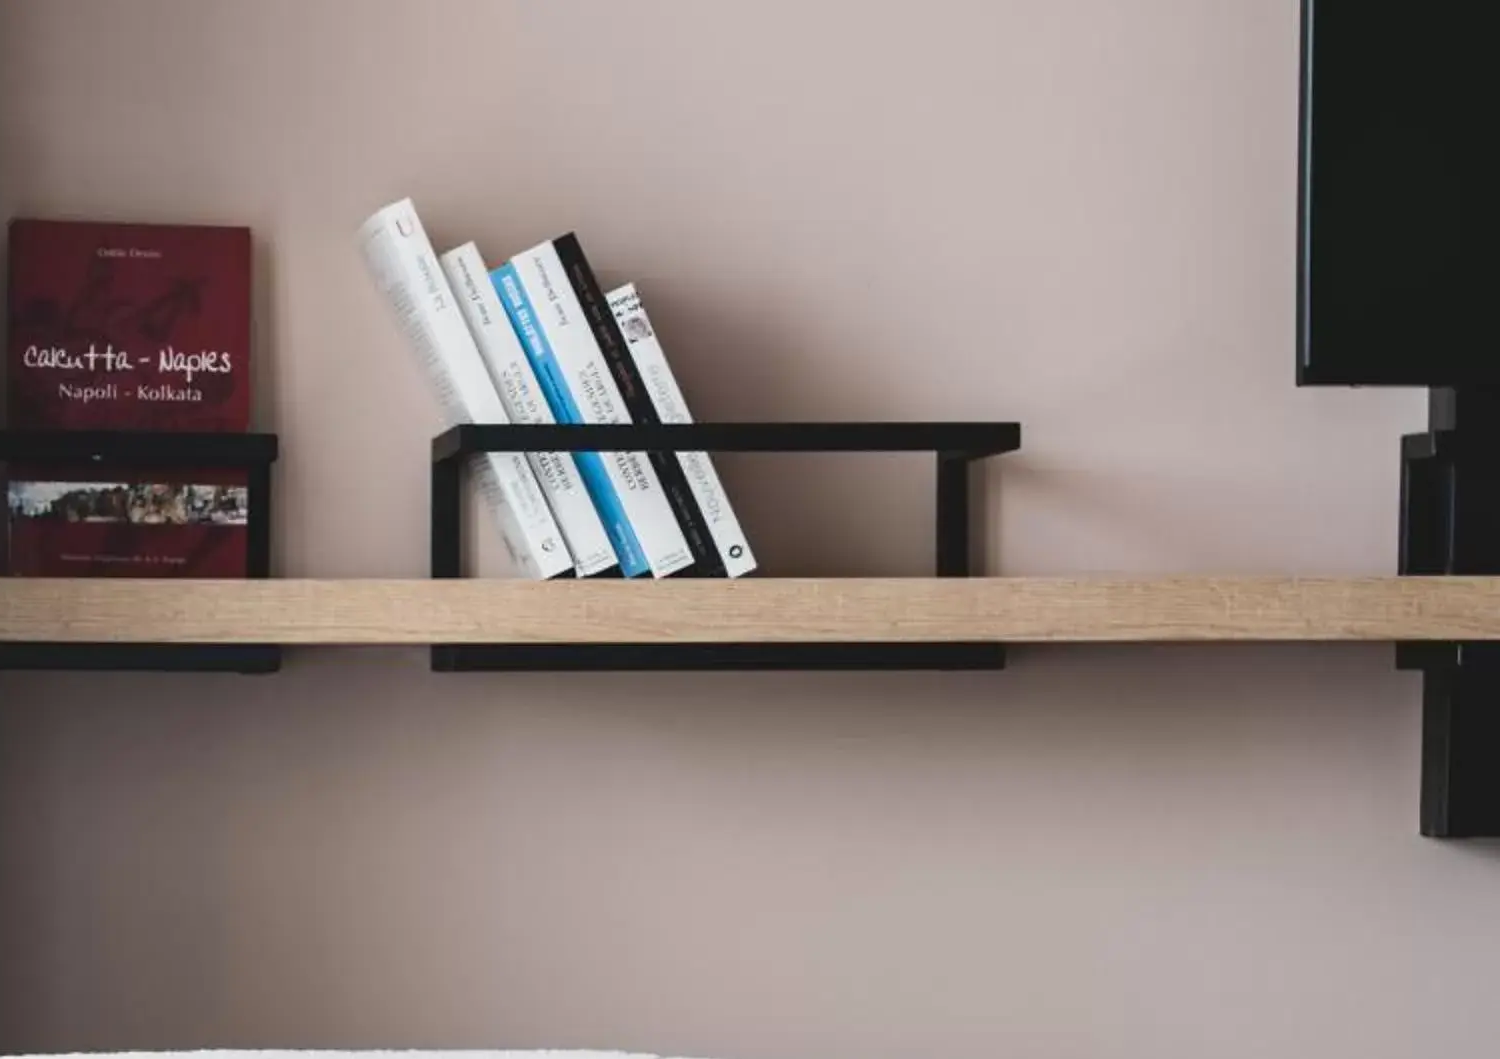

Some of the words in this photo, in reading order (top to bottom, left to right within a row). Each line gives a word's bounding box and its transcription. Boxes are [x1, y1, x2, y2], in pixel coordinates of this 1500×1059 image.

[23, 344, 133, 372] Calcutta
[159, 346, 232, 382] Naples
[58, 383, 117, 403] Napoli
[137, 384, 202, 401] Kolkata
